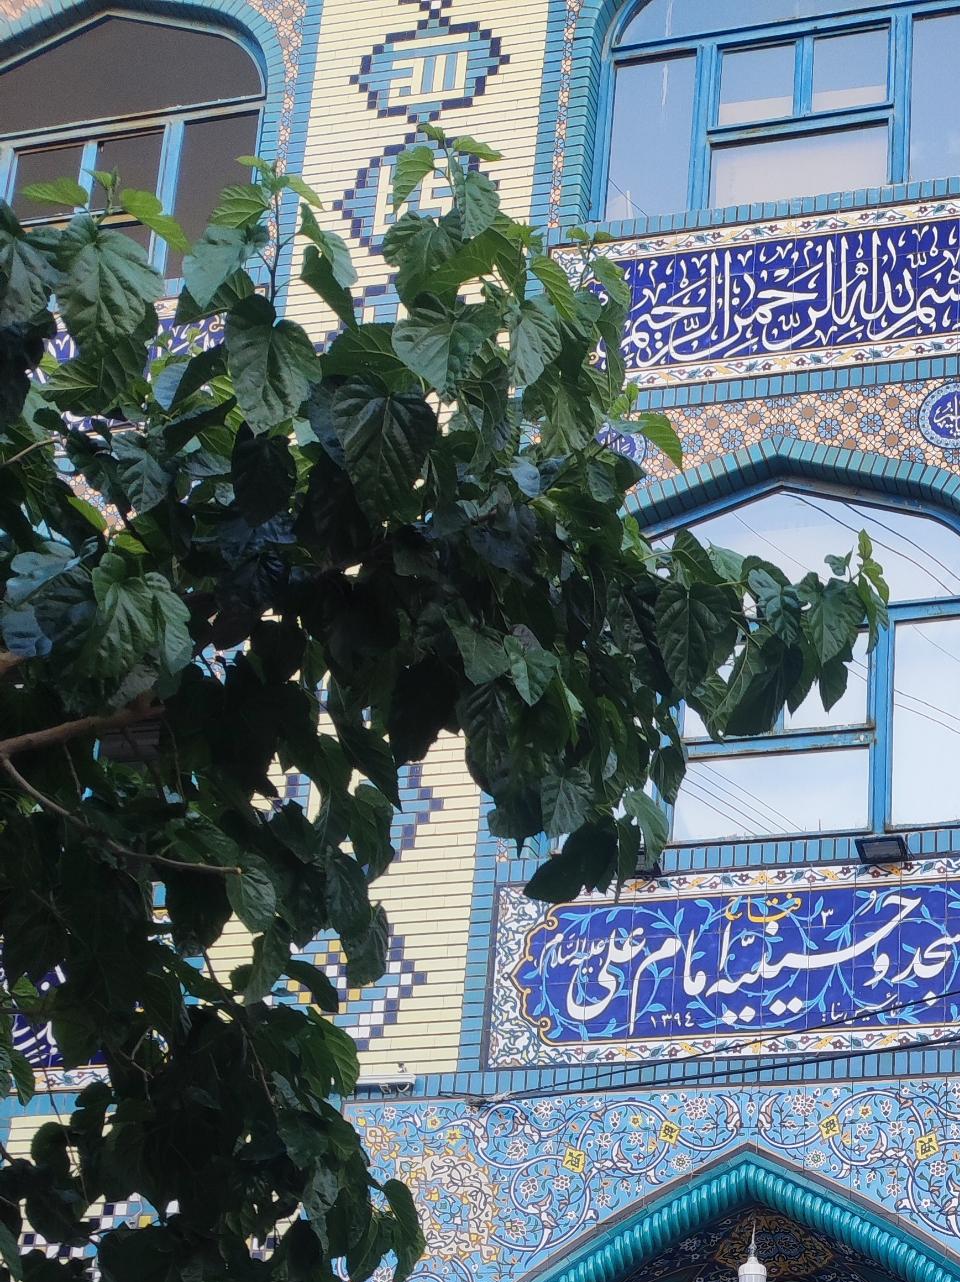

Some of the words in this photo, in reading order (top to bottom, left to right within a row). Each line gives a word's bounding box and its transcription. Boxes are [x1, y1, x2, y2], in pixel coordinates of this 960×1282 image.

[832, 231, 914, 325] الله
[567, 928, 645, 1020] علی
[630, 921, 731, 1036] امام
[863, 953, 890, 987] و
